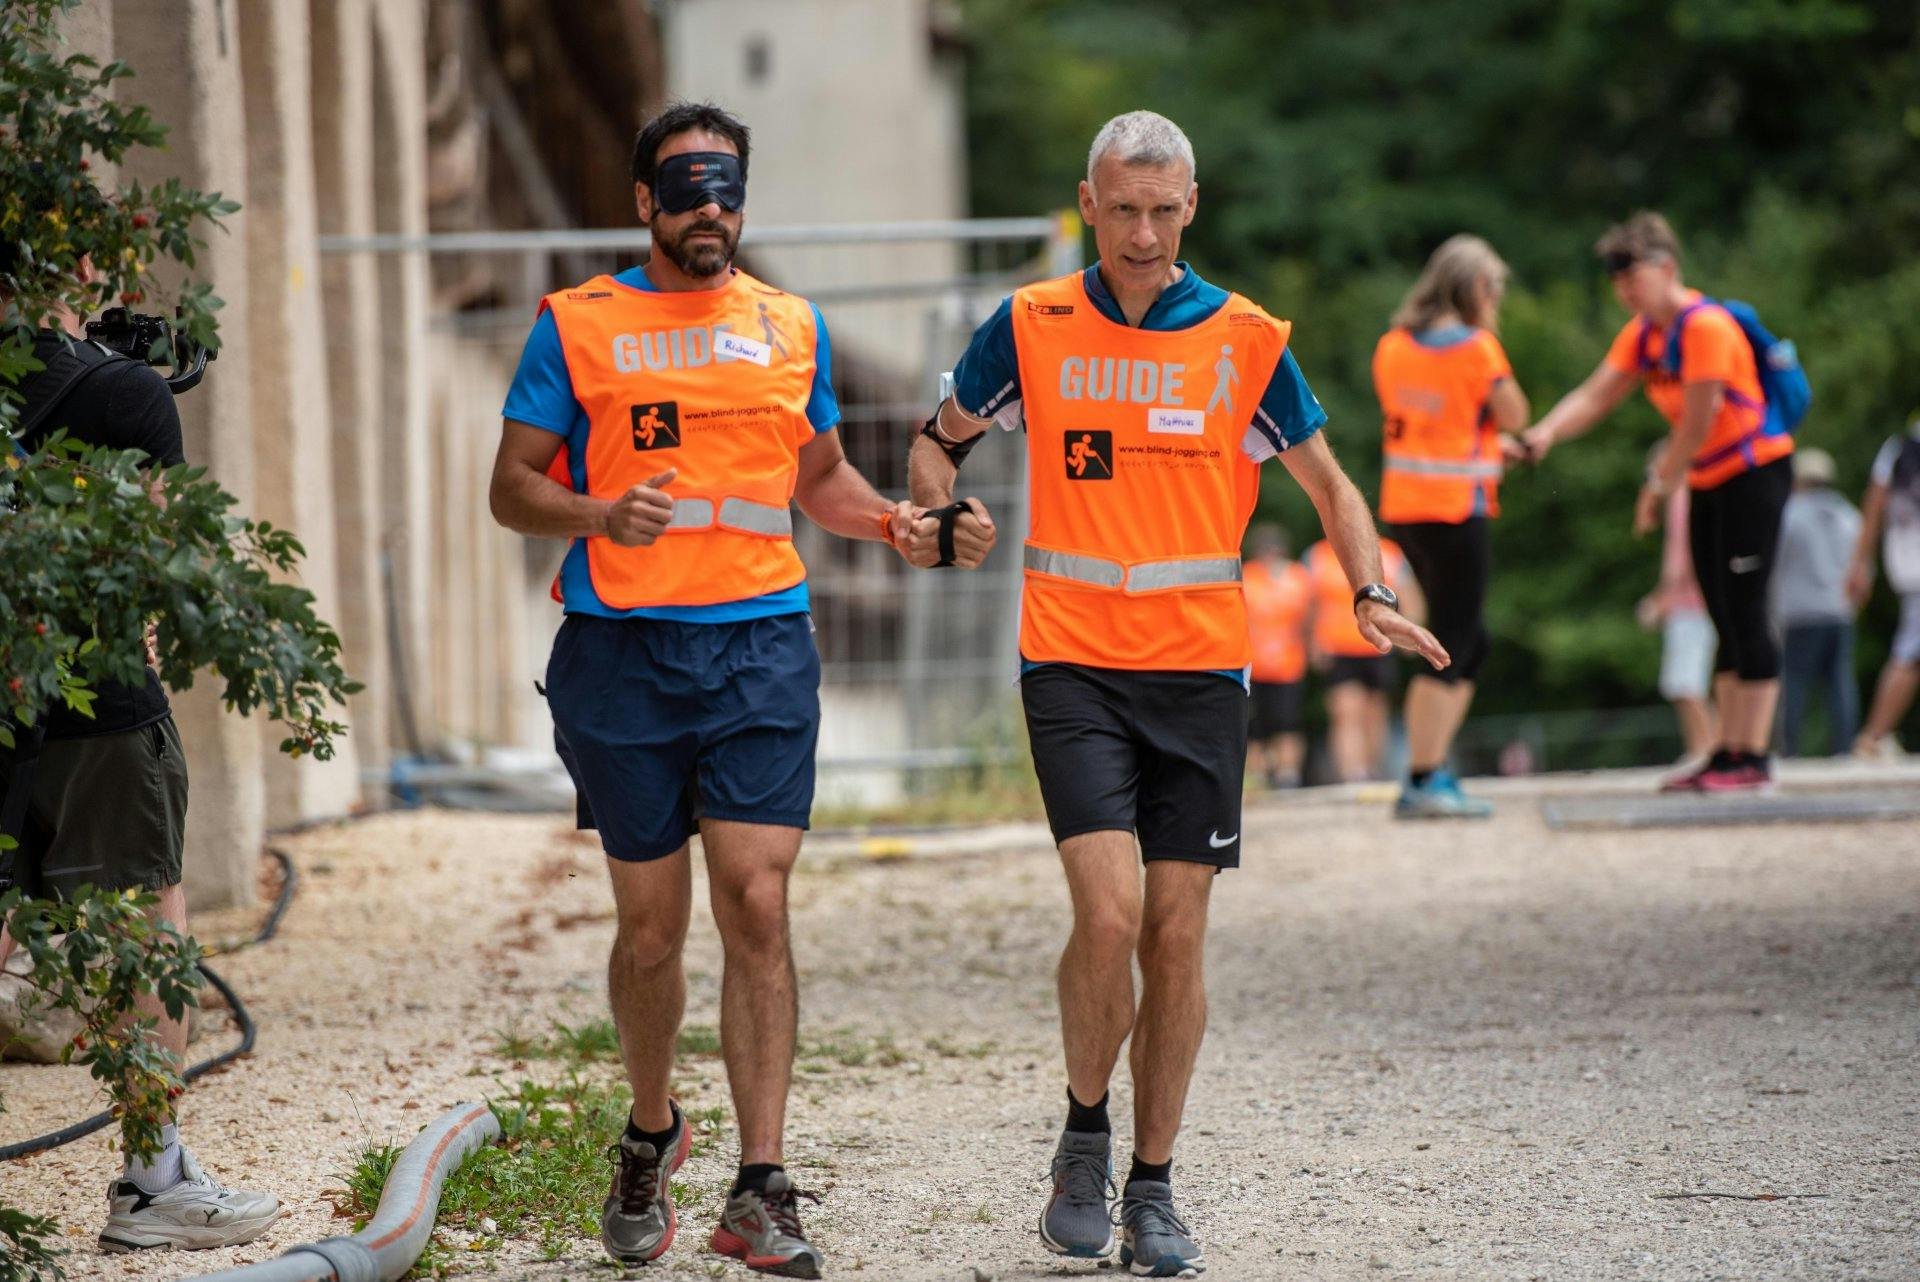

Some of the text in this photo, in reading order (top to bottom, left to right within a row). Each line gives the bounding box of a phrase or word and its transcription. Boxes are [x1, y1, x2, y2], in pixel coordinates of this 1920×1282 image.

[724, 340, 760, 358] Richard
[1059, 356, 1186, 405] GUIDE
[684, 404, 783, 420] www.blind-jogging.ch
[1118, 445, 1221, 458] www.blind-joggingch
